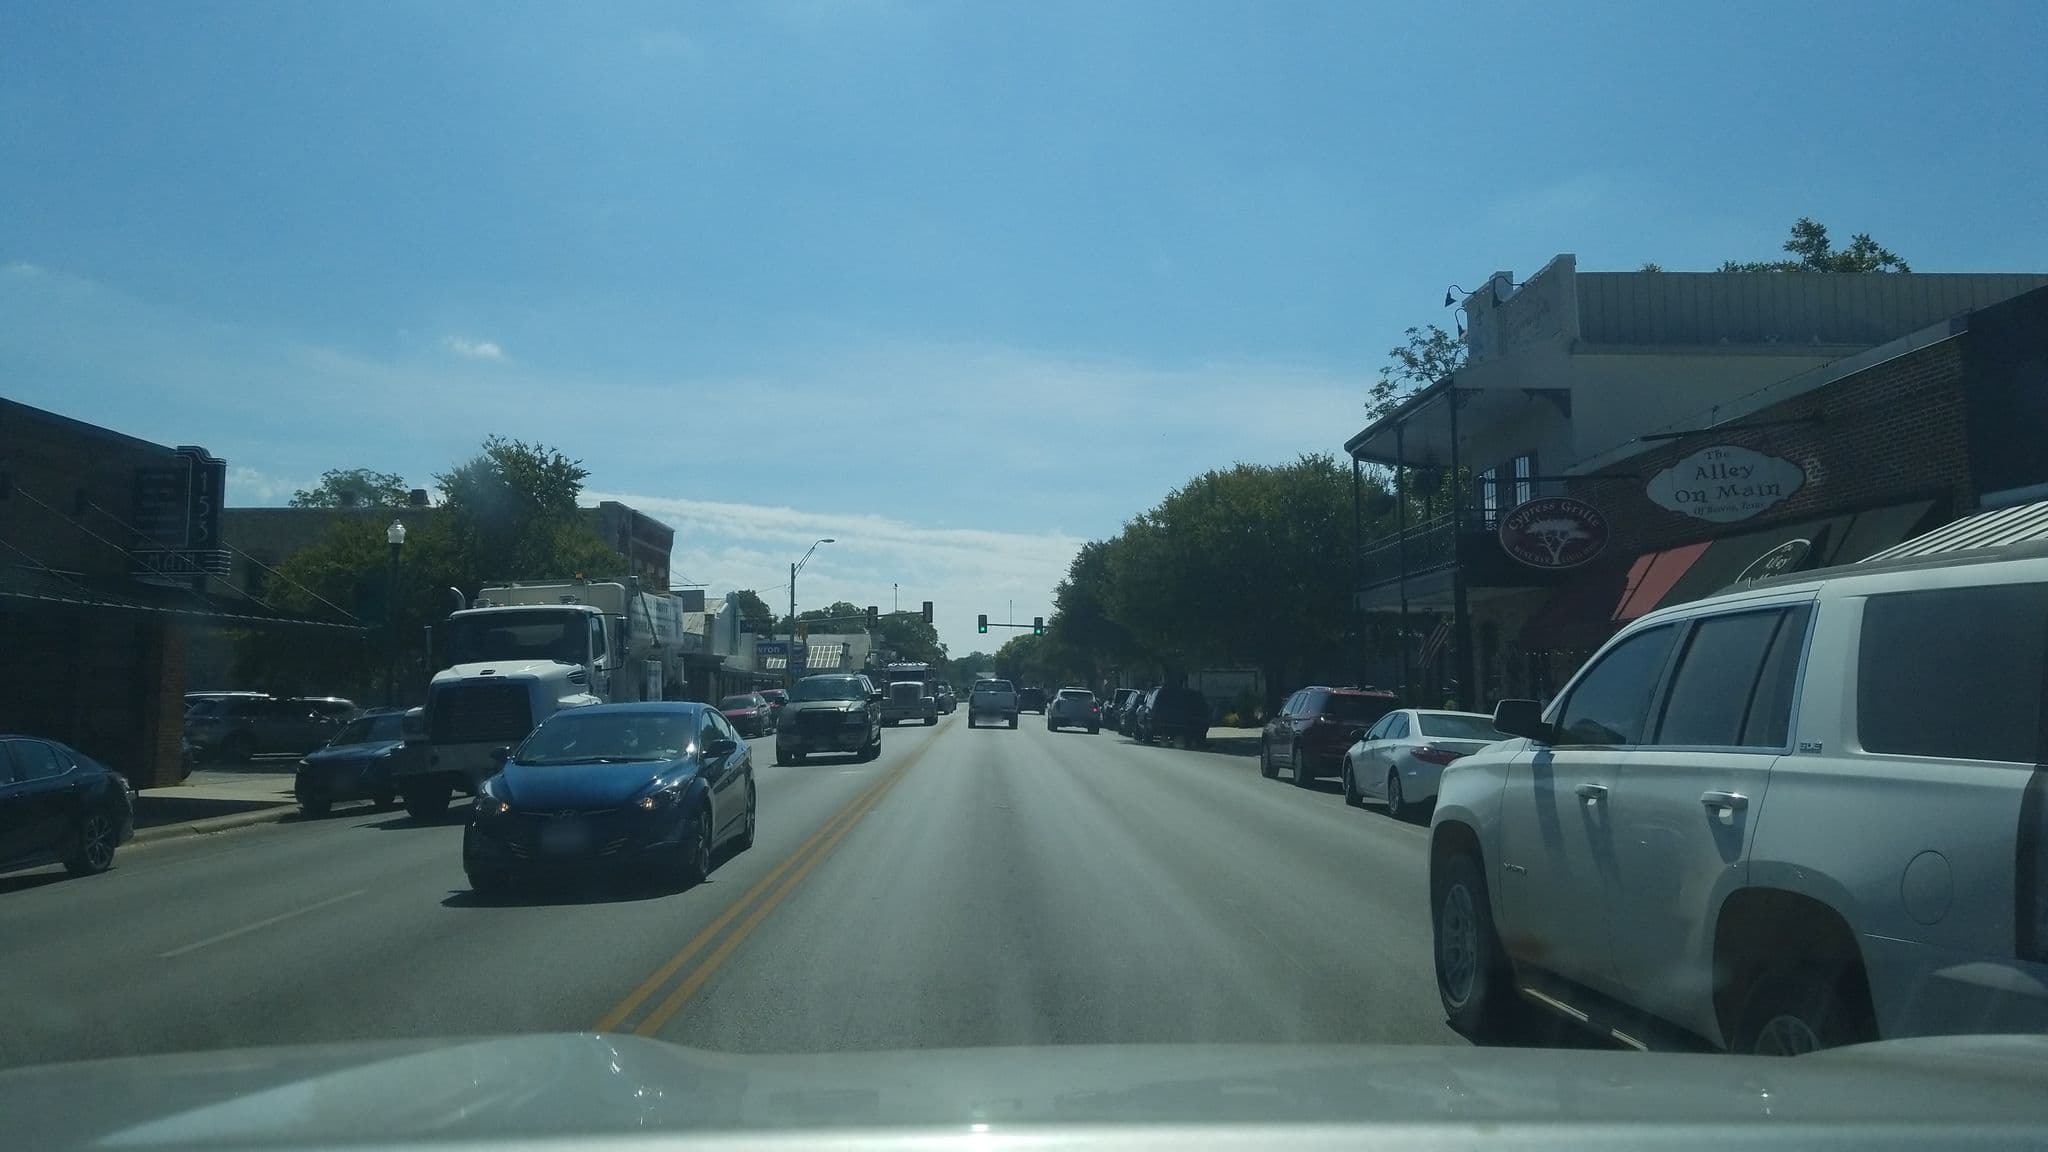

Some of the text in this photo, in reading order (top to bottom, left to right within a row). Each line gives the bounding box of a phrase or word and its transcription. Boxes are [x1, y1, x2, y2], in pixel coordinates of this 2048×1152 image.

[1703, 449, 1728, 461] The
[1695, 463, 1754, 481] Alley
[1674, 483, 1783, 504] On Main
[1508, 502, 1600, 530] Cypress Grille
